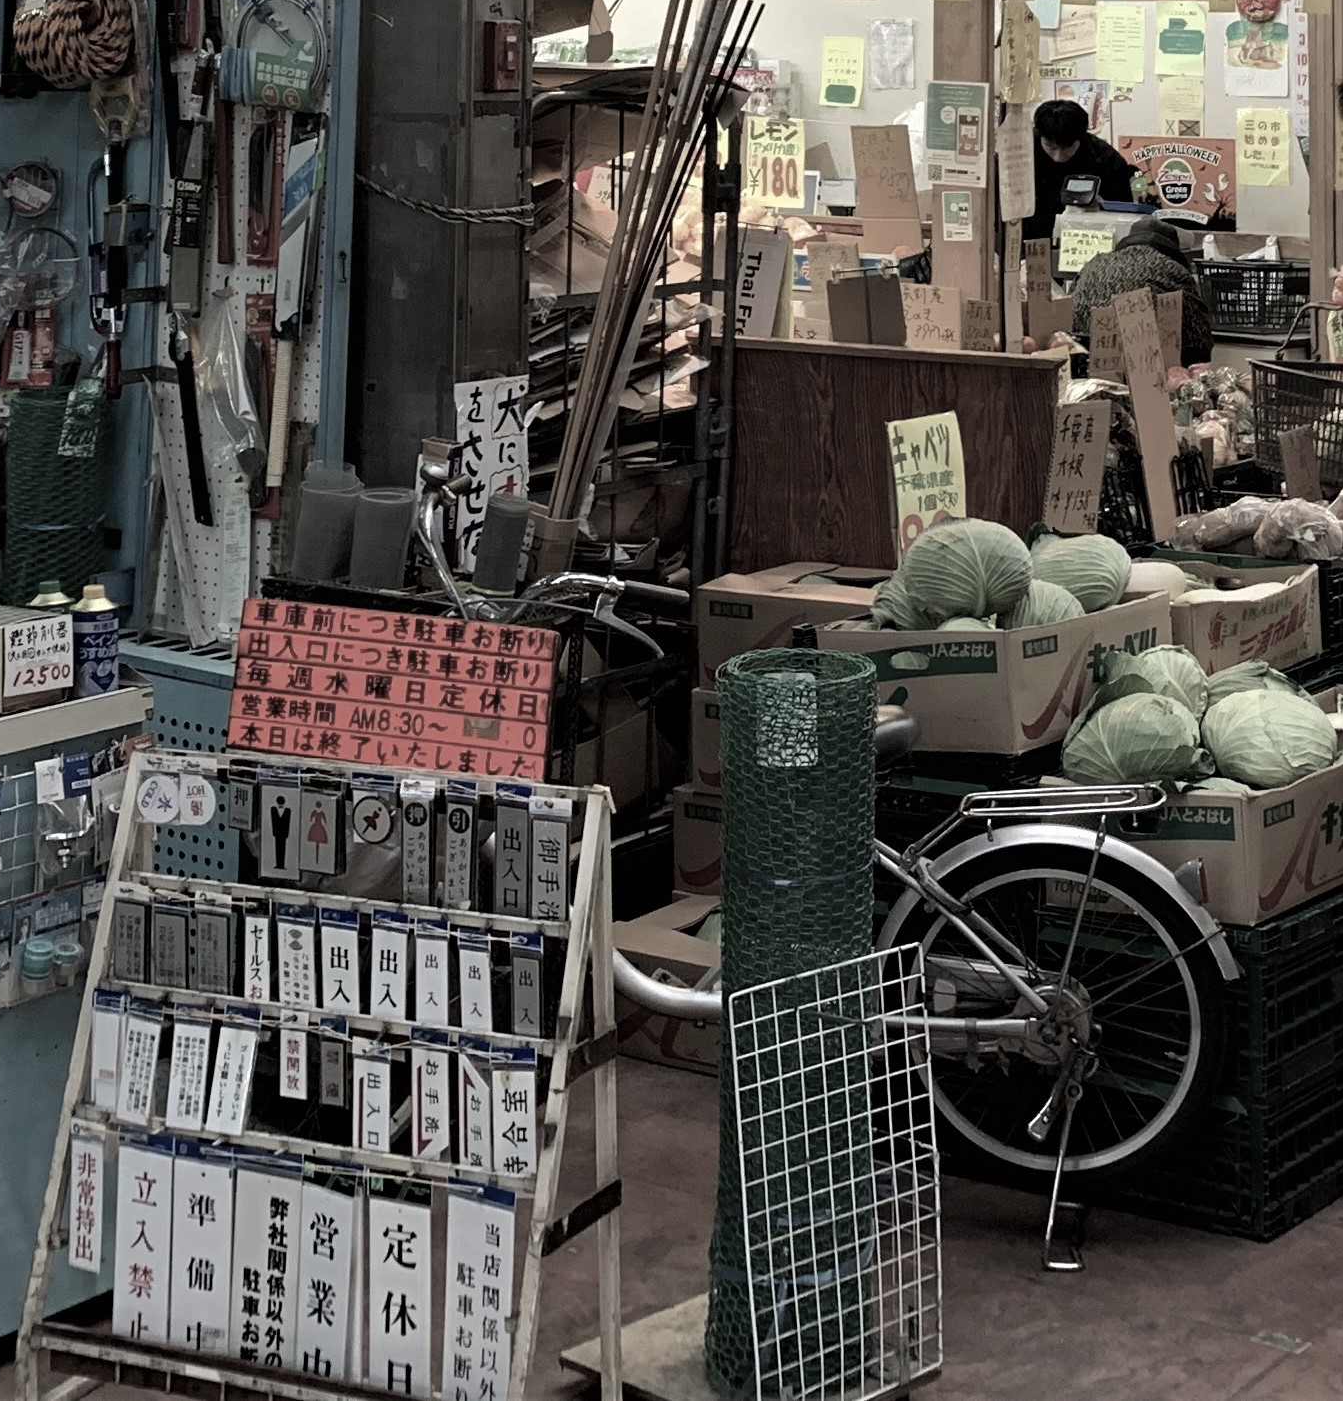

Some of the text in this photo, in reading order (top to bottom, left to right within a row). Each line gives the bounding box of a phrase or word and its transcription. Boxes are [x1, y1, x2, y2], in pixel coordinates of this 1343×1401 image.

[750, 118, 799, 142] レモン
[1244, 119, 1281, 132] 三の市
[1244, 134, 1281, 148] 始めま
[1133, 143, 1220, 166] HAPPY HALLOWEEN
[1165, 185, 1188, 195] Green
[741, 250, 763, 300] Thai
[892, 423, 951, 475] キャベツ
[896, 470, 955, 493] 千葉県産
[254, 602, 547, 656] 車庫前につき駐車お断り
[927, 642, 997, 659] JAとよはし
[248, 632, 541, 687] 出入口につき駐車お断り
[241, 693, 337, 725] 営業時間
[246, 661, 539, 718] 毎週水曜日定休日
[239, 722, 537, 779] 本日は終了いたしました
[140, 780, 159, 809] COLD
[157, 795, 173, 813] 水
[186, 784, 206, 797] HOT
[502, 827, 522, 908] 出入口
[330, 945, 351, 1003] 出入
[378, 948, 398, 1008] 出入
[424, 953, 439, 1007] 出入
[467, 964, 483, 1018] 出入
[517, 969, 535, 1026] 出入
[424, 1058, 441, 1134] お手洗
[75, 1152, 98, 1263] 非常持出
[264, 1196, 291, 1369] 弊社関係以外の
[381, 1224, 418, 1395] 定休日
